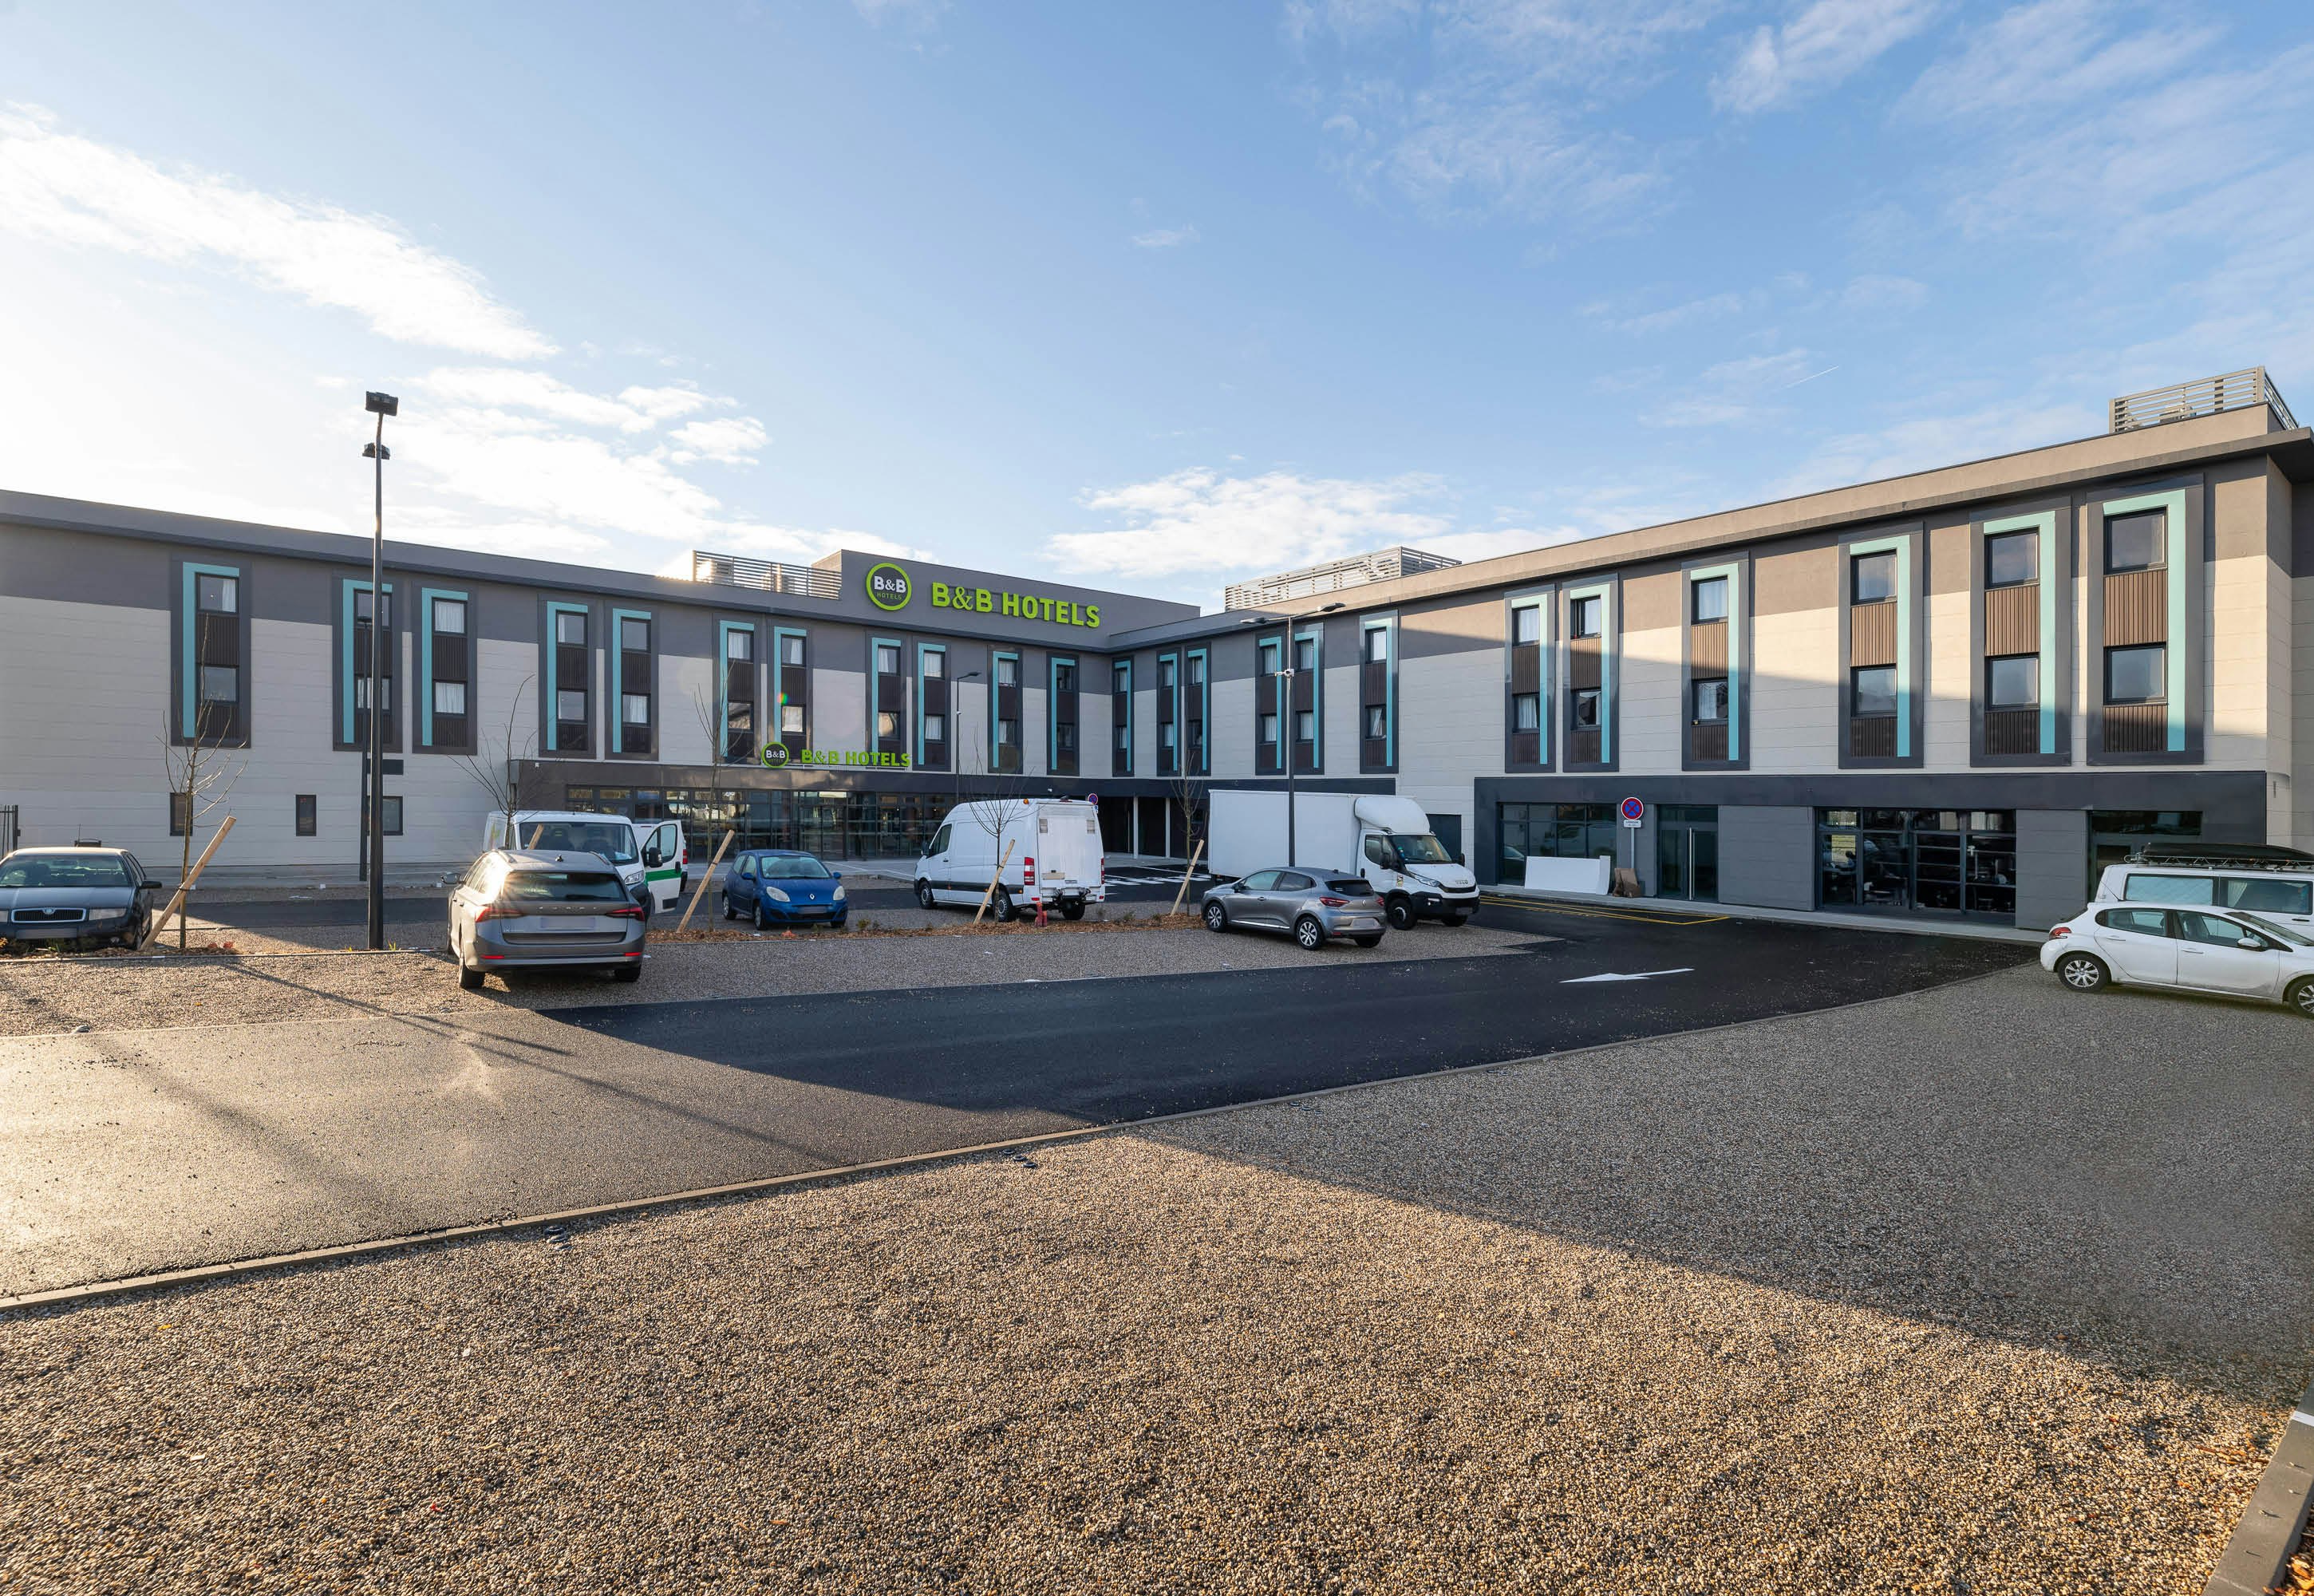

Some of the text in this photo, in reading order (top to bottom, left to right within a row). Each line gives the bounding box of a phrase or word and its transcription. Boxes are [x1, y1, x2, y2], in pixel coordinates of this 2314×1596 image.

[874, 575, 906, 593] B&B
[876, 591, 902, 600] HOTELS
[932, 582, 1100, 628] B&B HOTELS
[801, 749, 910, 767] B&B HOTELS
